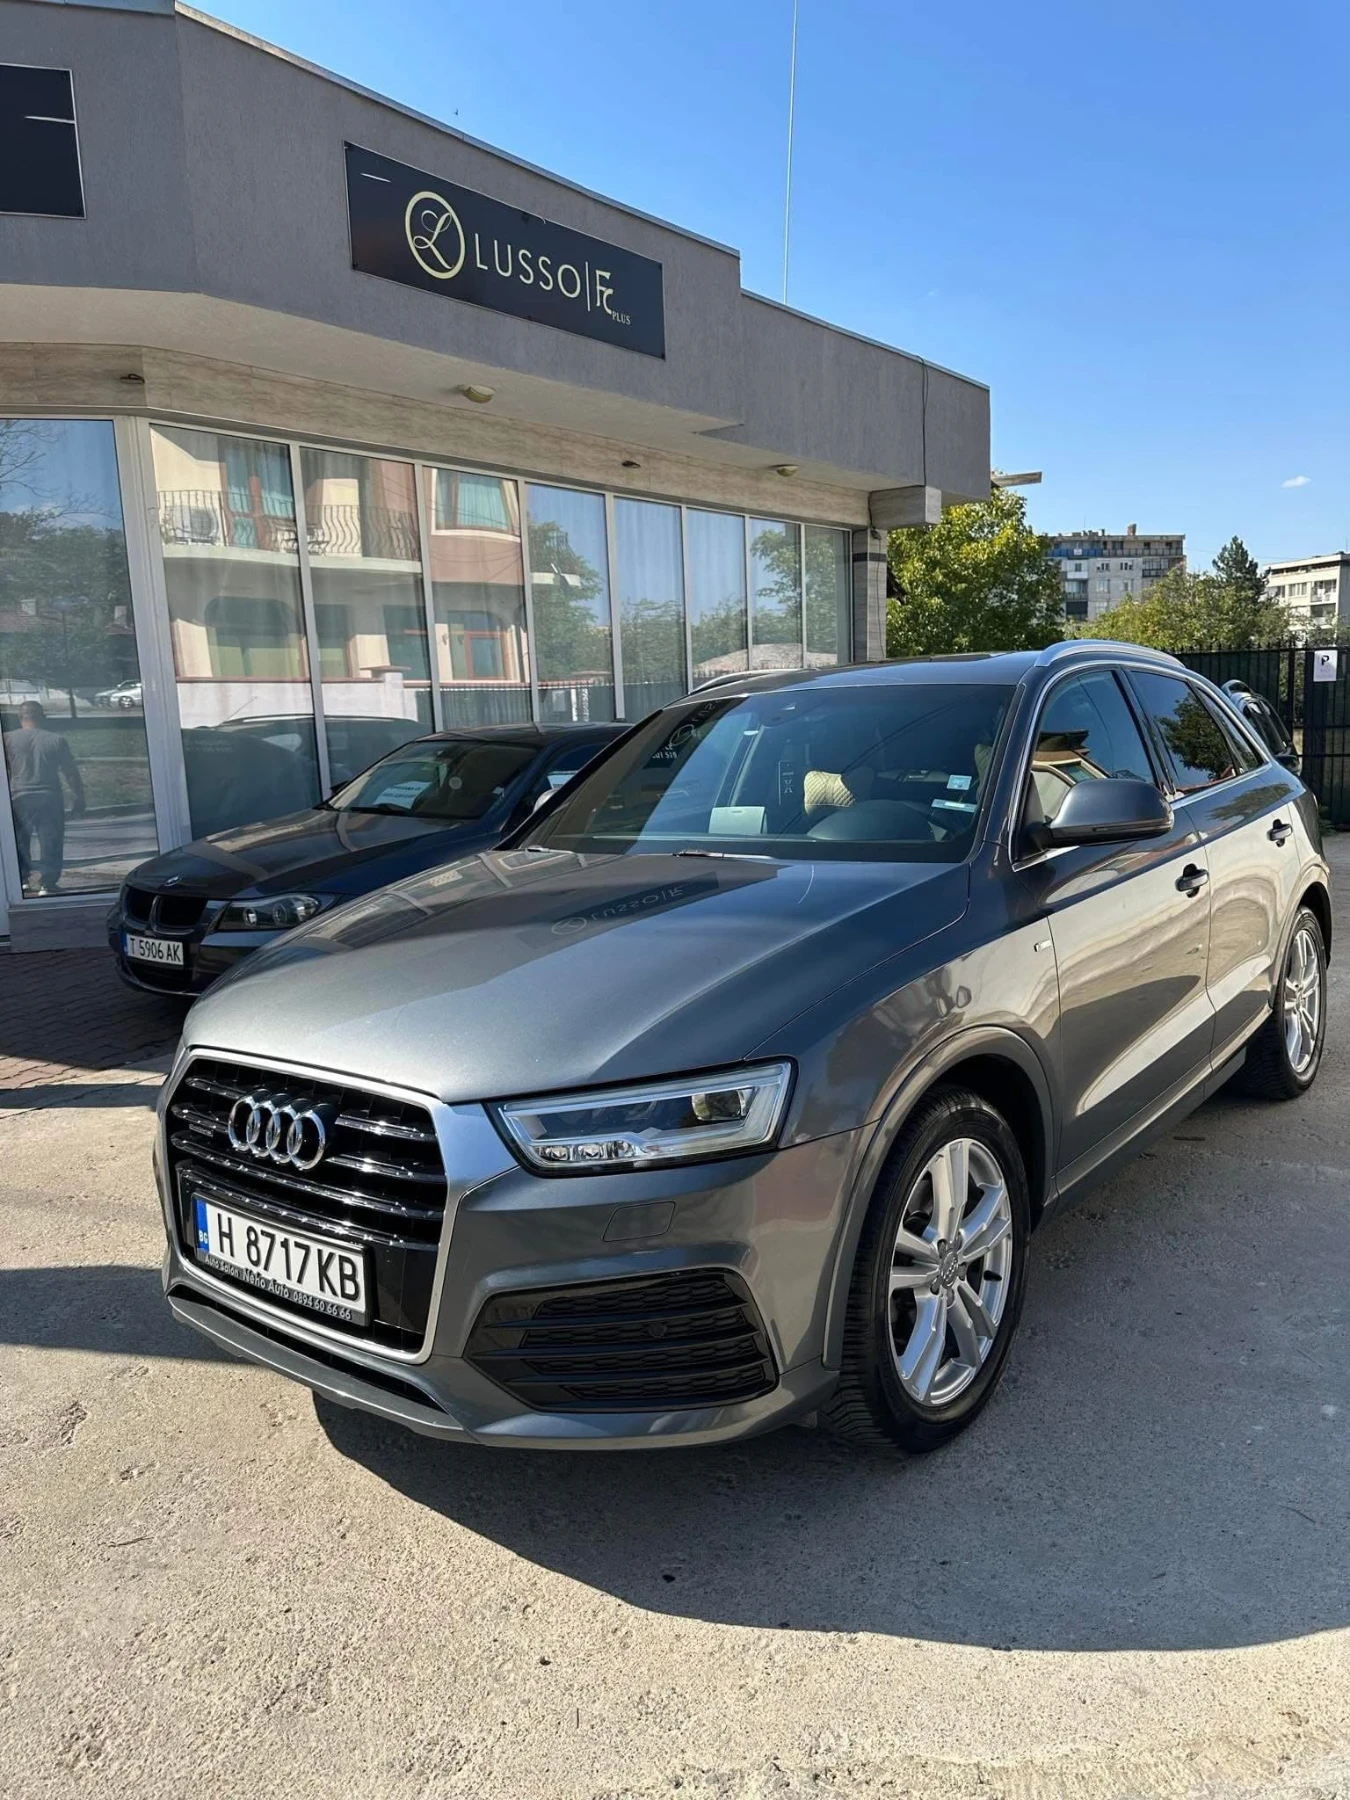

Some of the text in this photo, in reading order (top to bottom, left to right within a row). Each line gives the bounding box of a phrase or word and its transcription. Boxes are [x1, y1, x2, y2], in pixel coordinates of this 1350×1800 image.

[474, 232, 581, 298] LUSSO
[612, 311, 631, 326] PLUS
[1321, 655, 1330, 666] P
[139, 940, 164, 960] 5906
[166, 943, 182, 962] AK
[198, 1229, 209, 1245] BG
[217, 1212, 362, 1303] H 8717 KB
[204, 1254, 220, 1269] Auto
[267, 1280, 290, 1299] Auto
[293, 1290, 313, 1308] 0894
[314, 1298, 326, 1312] 60
[326, 1303, 338, 1316] 66
[339, 1307, 352, 1321] 66
